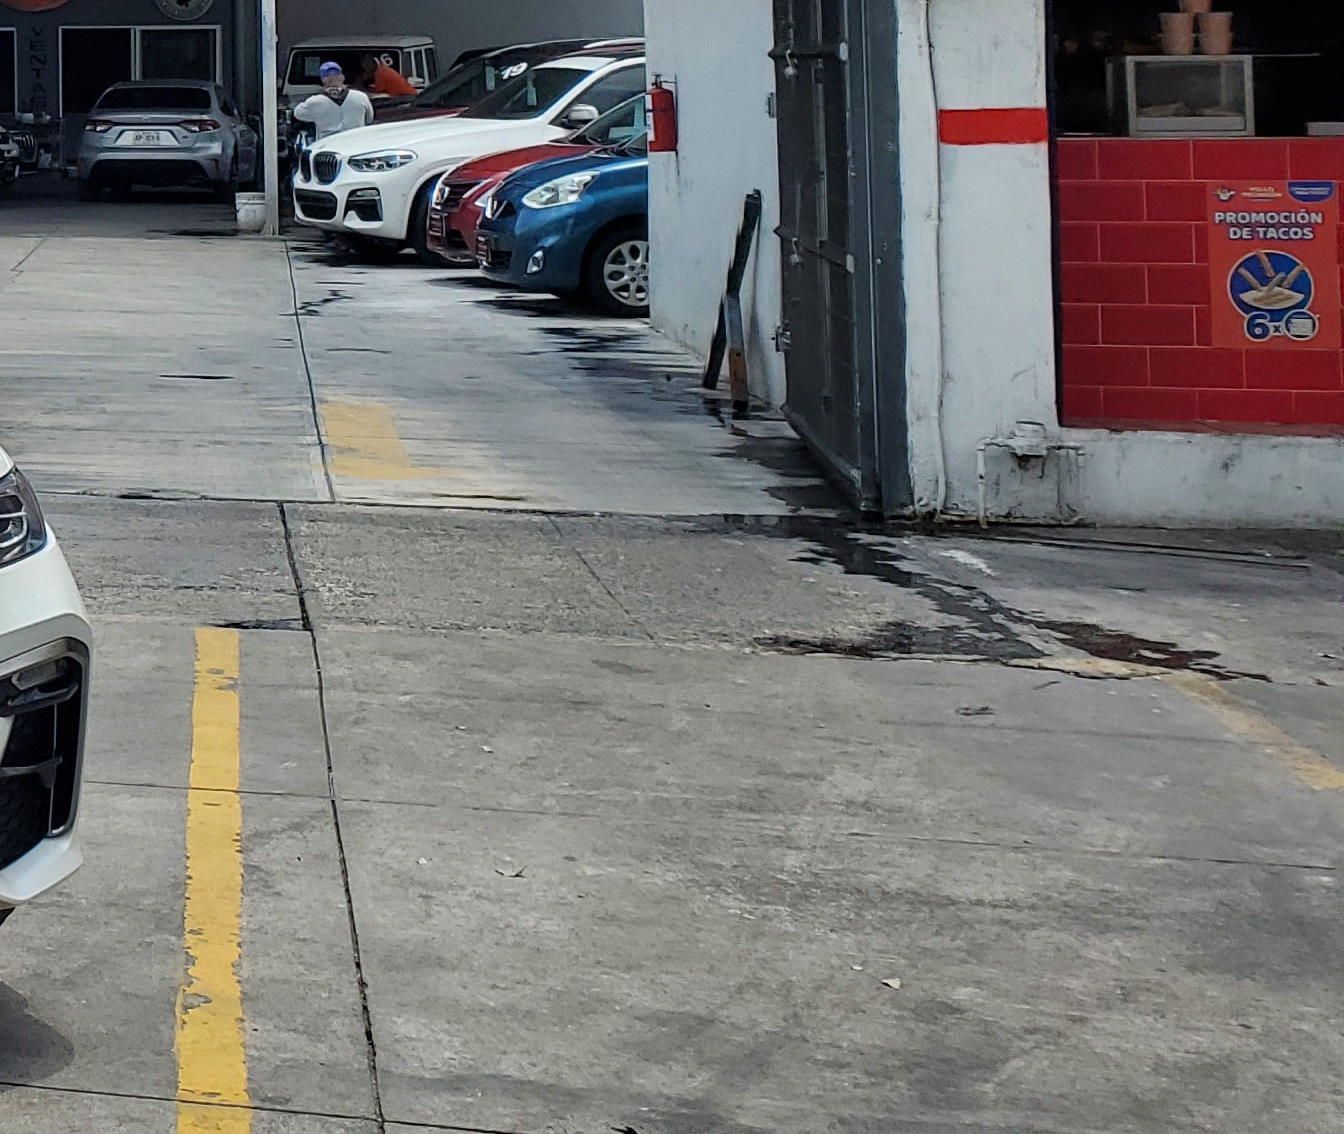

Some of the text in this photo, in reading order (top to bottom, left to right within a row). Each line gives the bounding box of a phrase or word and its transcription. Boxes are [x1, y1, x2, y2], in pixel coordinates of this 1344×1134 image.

[1214, 209, 1323, 224] PROMOCIÓN
[1229, 227, 1315, 240] DE TACOS
[1246, 313, 1270, 340] 6
